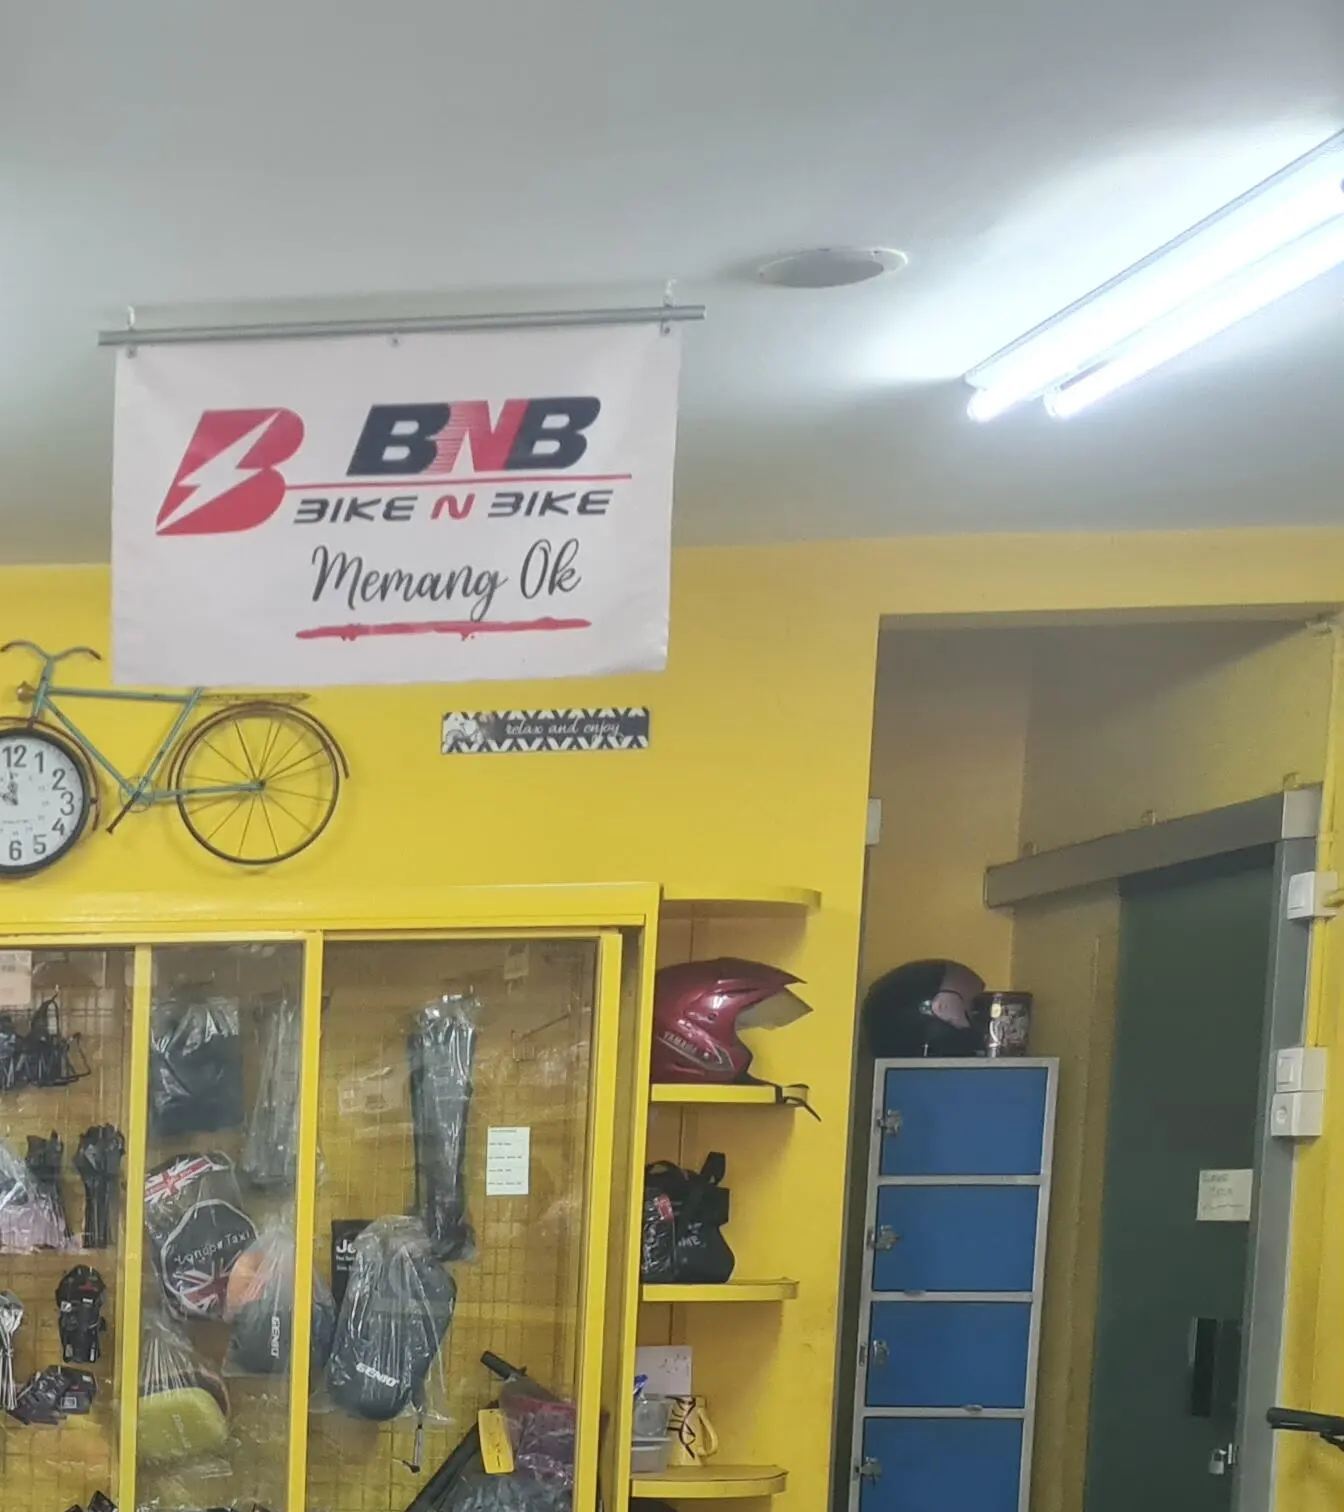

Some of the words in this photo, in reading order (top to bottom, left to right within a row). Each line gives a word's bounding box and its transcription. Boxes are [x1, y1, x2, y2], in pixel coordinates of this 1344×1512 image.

[346, 396, 601, 476] BNB
[294, 495, 418, 524] BIKE
[430, 493, 475, 520] N
[488, 489, 613, 522] BIKE
[311, 546, 508, 622] Memang
[519, 538, 582, 599] Ok
[548, 718, 579, 734] and
[2, 744, 27, 768] 12
[35, 752, 44, 773] 1
[52, 769, 66, 791] 2
[60, 791, 74, 816] 3
[52, 817, 65, 836] 4
[9, 840, 22, 860] 6
[33, 834, 46, 854] 5
